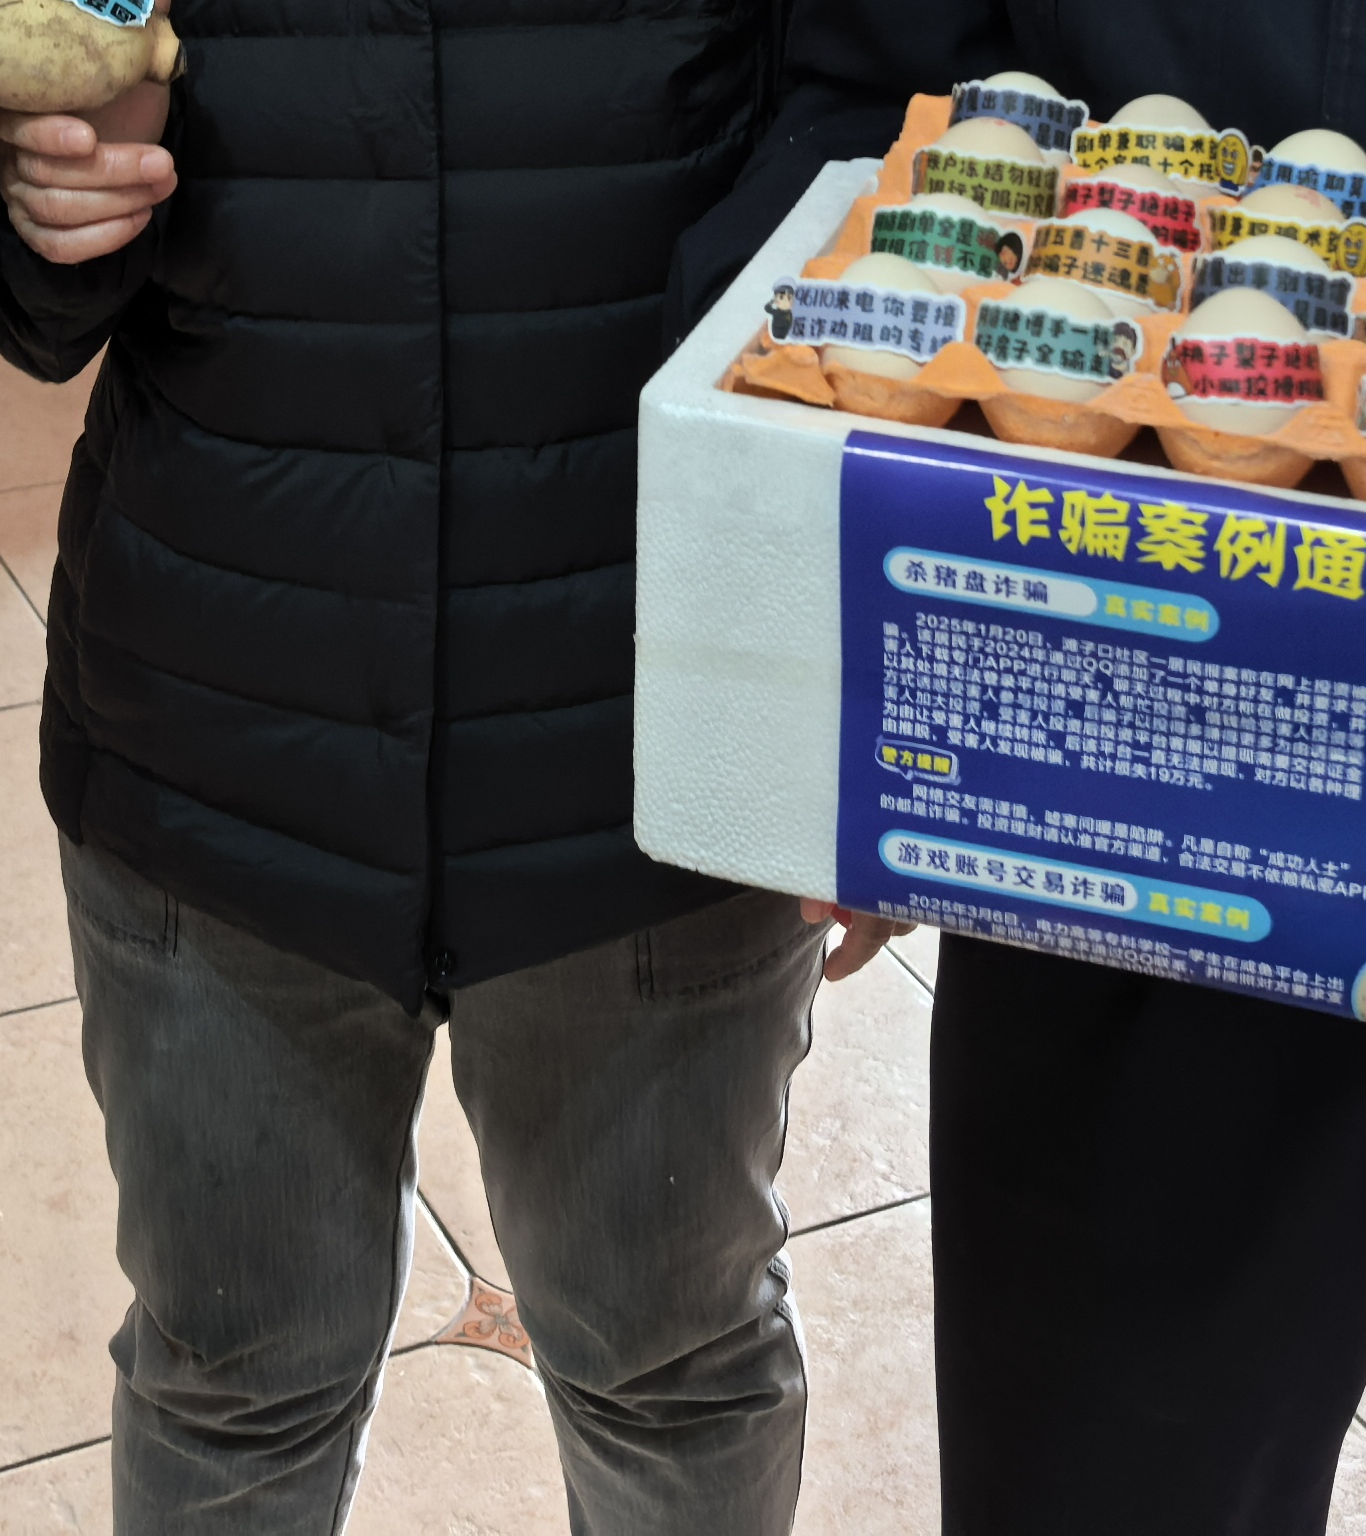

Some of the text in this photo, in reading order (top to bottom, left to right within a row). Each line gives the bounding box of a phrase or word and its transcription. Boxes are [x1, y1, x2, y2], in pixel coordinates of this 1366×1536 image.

[904, 560, 1049, 606] 杀猪盘诈骗
[1103, 594, 1211, 633] 真实案例
[898, 841, 1125, 907] 游戏账号交易诈骗
[1148, 891, 1250, 932] 真实案例
